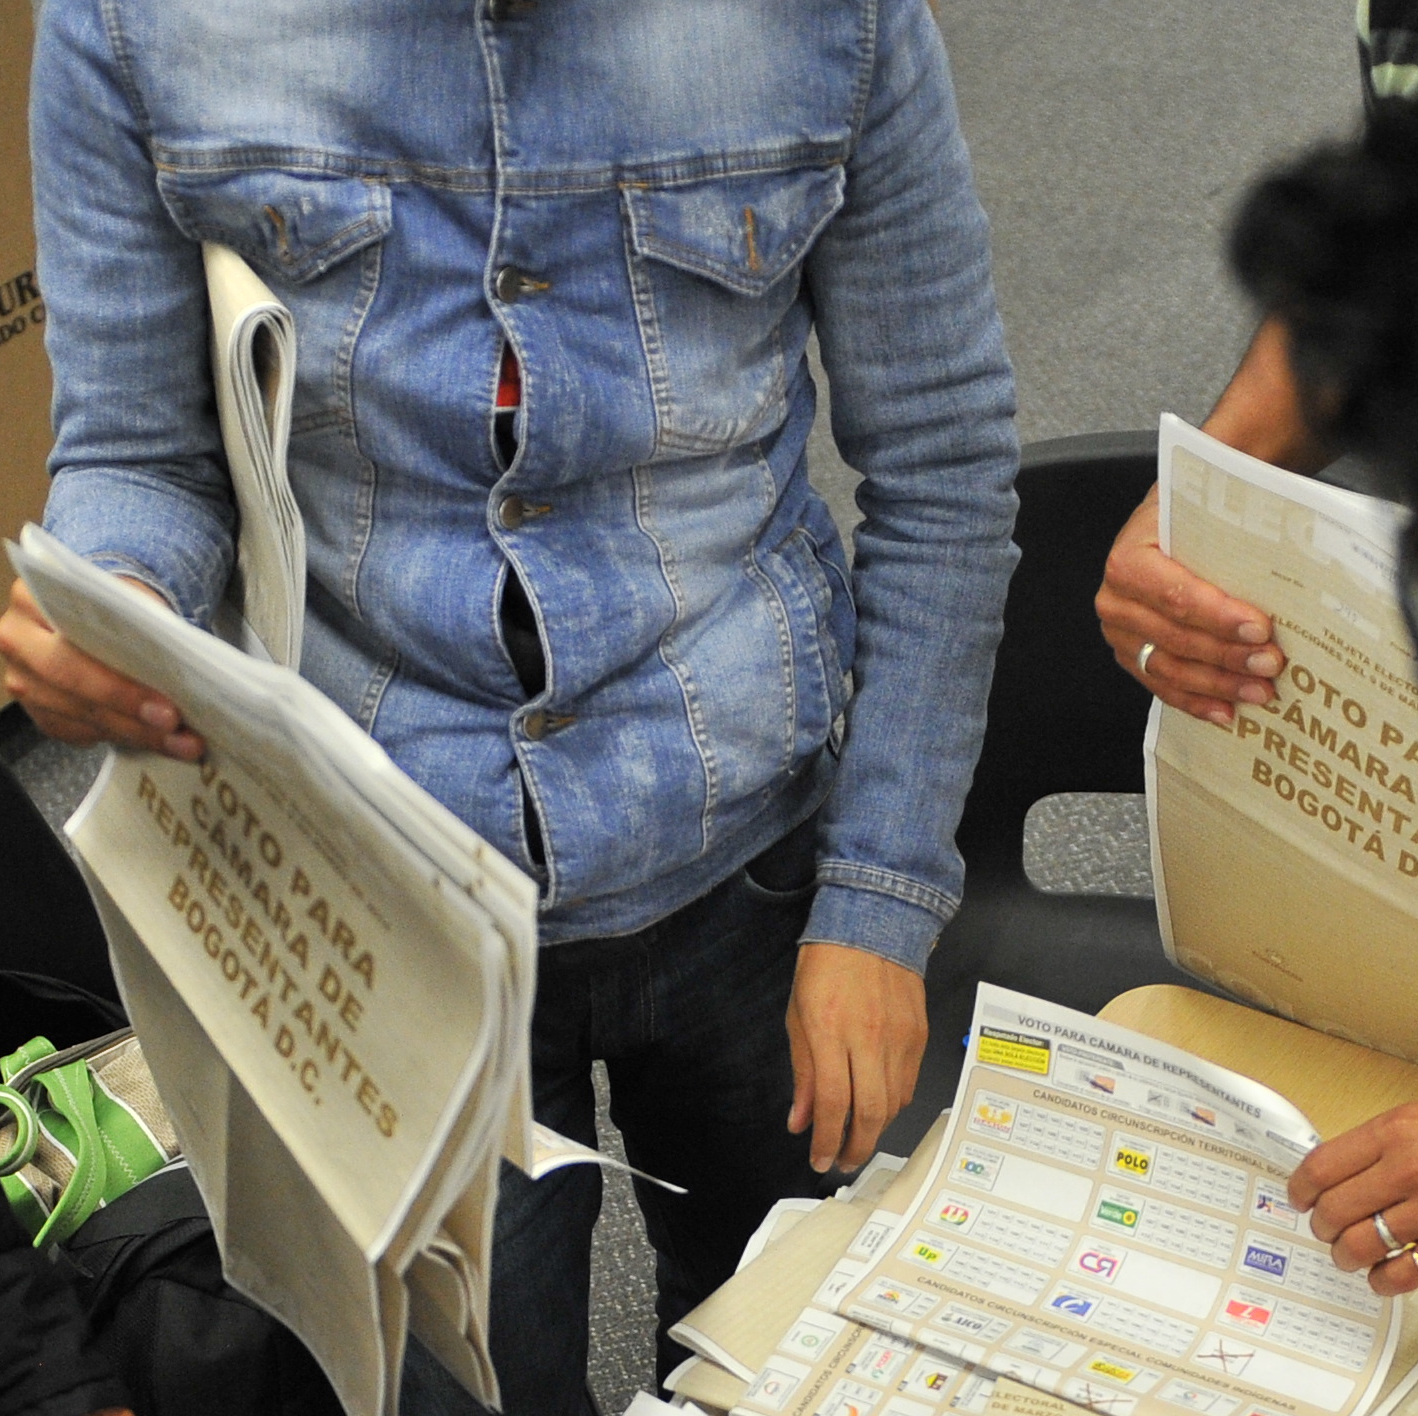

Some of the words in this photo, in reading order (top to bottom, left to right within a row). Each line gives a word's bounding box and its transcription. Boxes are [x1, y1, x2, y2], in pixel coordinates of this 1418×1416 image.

[1271, 613, 1342, 662] ELECCIONES
[1345, 661, 1366, 678] DEL
[1323, 627, 1370, 666] TARJETA
[1285, 657, 1367, 729] OTO
[1251, 757, 1386, 863] BOGOTÁ
[138, 773, 398, 1138] REPRESENTANTES
[291, 866, 374, 991] PARA
[319, 964, 364, 1033] DE
[274, 1023, 321, 1106] D.C.
[1018, 1014, 1052, 1034] VOTO
[1054, 1025, 1086, 1045] PARA
[1089, 1036, 1141, 1063] CÁMARA
[1143, 1054, 1160, 1069] DE
[1162, 1062, 1261, 1118] REPRESENTANTES
[1033, 1089, 1098, 1117] CANDIDATOS
[1100, 1109, 1195, 1146] CIRCUNSCRIPCIÓN
[1199, 1140, 1265, 1171] TERRITORIAL
[1116, 1151, 1149, 1170] POLO
[1248, 1251, 1284, 1270] MIRA
[917, 1276, 985, 1305] CANDIDATOS
[987, 1302, 1088, 1342] CIRCUNSCRIPCIÓN
[1089, 1335, 1143, 1361] ESPECIAL
[1146, 1356, 1231, 1390] COMUNIDADES
[991, 1402, 1013, 1413] DE
